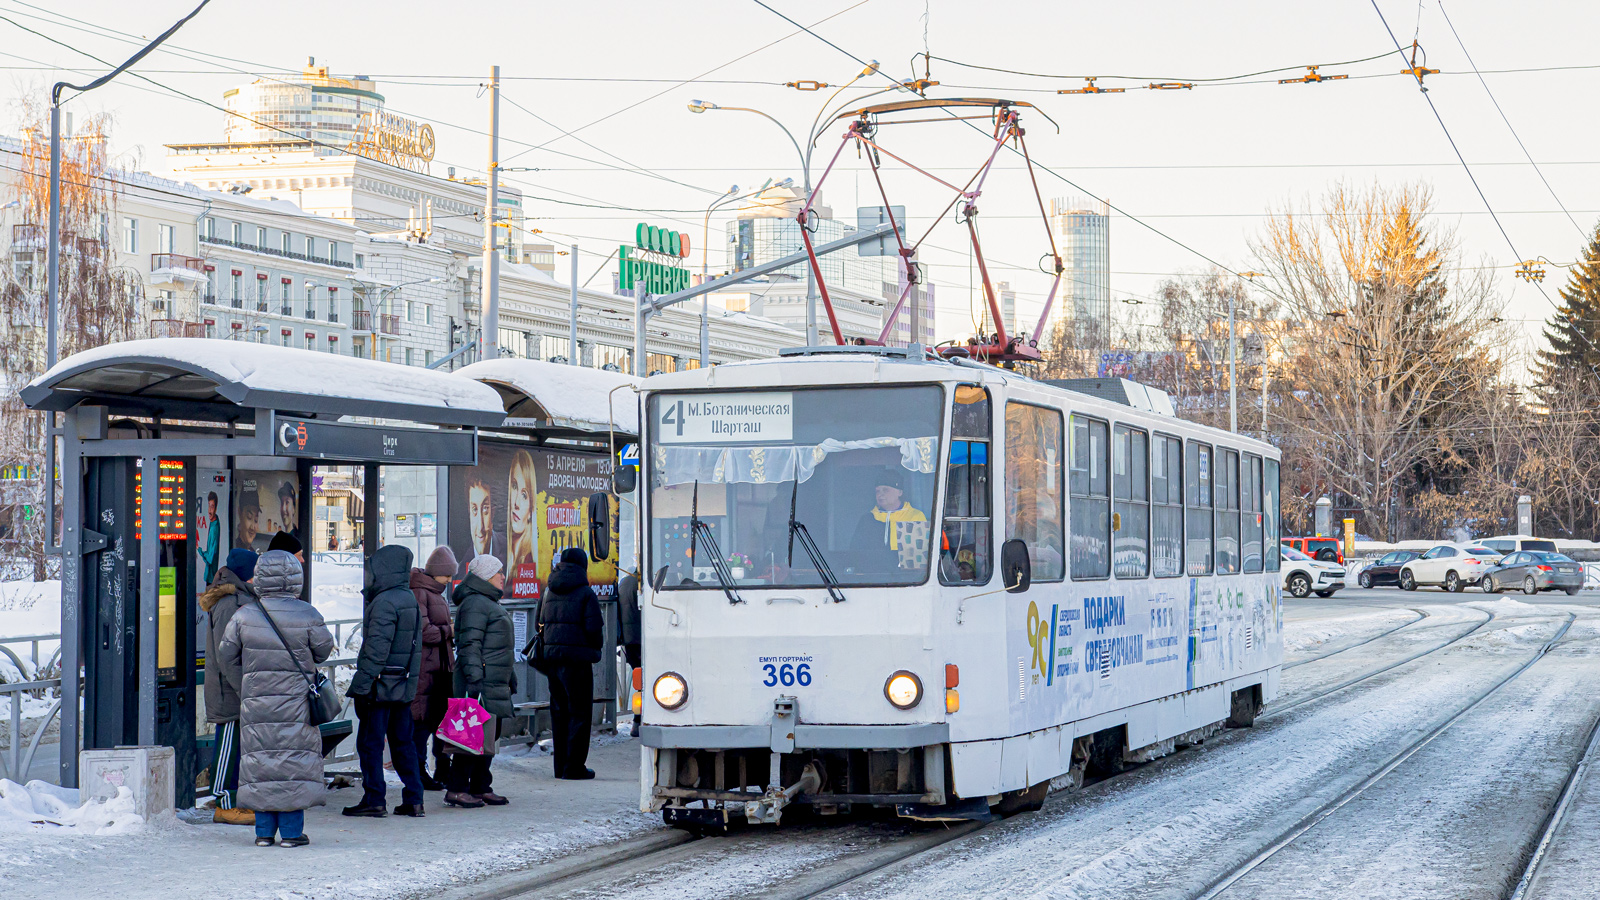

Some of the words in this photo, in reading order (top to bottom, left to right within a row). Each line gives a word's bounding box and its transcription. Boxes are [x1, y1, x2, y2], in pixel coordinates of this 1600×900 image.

[620, 245, 690, 301] ГРИНВИЧ
[661, 400, 686, 436] 4
[711, 419, 761, 436] Шарташ
[382, 434, 398, 448] Цирк
[383, 448, 395, 456] Circus
[546, 454, 554, 470] 15
[556, 459, 586, 473] АПРЕЛЯ
[597, 460, 612, 474] 19:0
[549, 473, 575, 490] ДВОРЕЦ
[576, 476, 610, 491] МОЛОДЕЖ
[547, 506, 581, 528] ПОСЛЕДНИЙ
[519, 567, 534, 579] Анна
[514, 582, 539, 595] АРДОВА
[1083, 595, 1126, 635] ПОДАРКИ
[762, 663, 812, 687] 366
